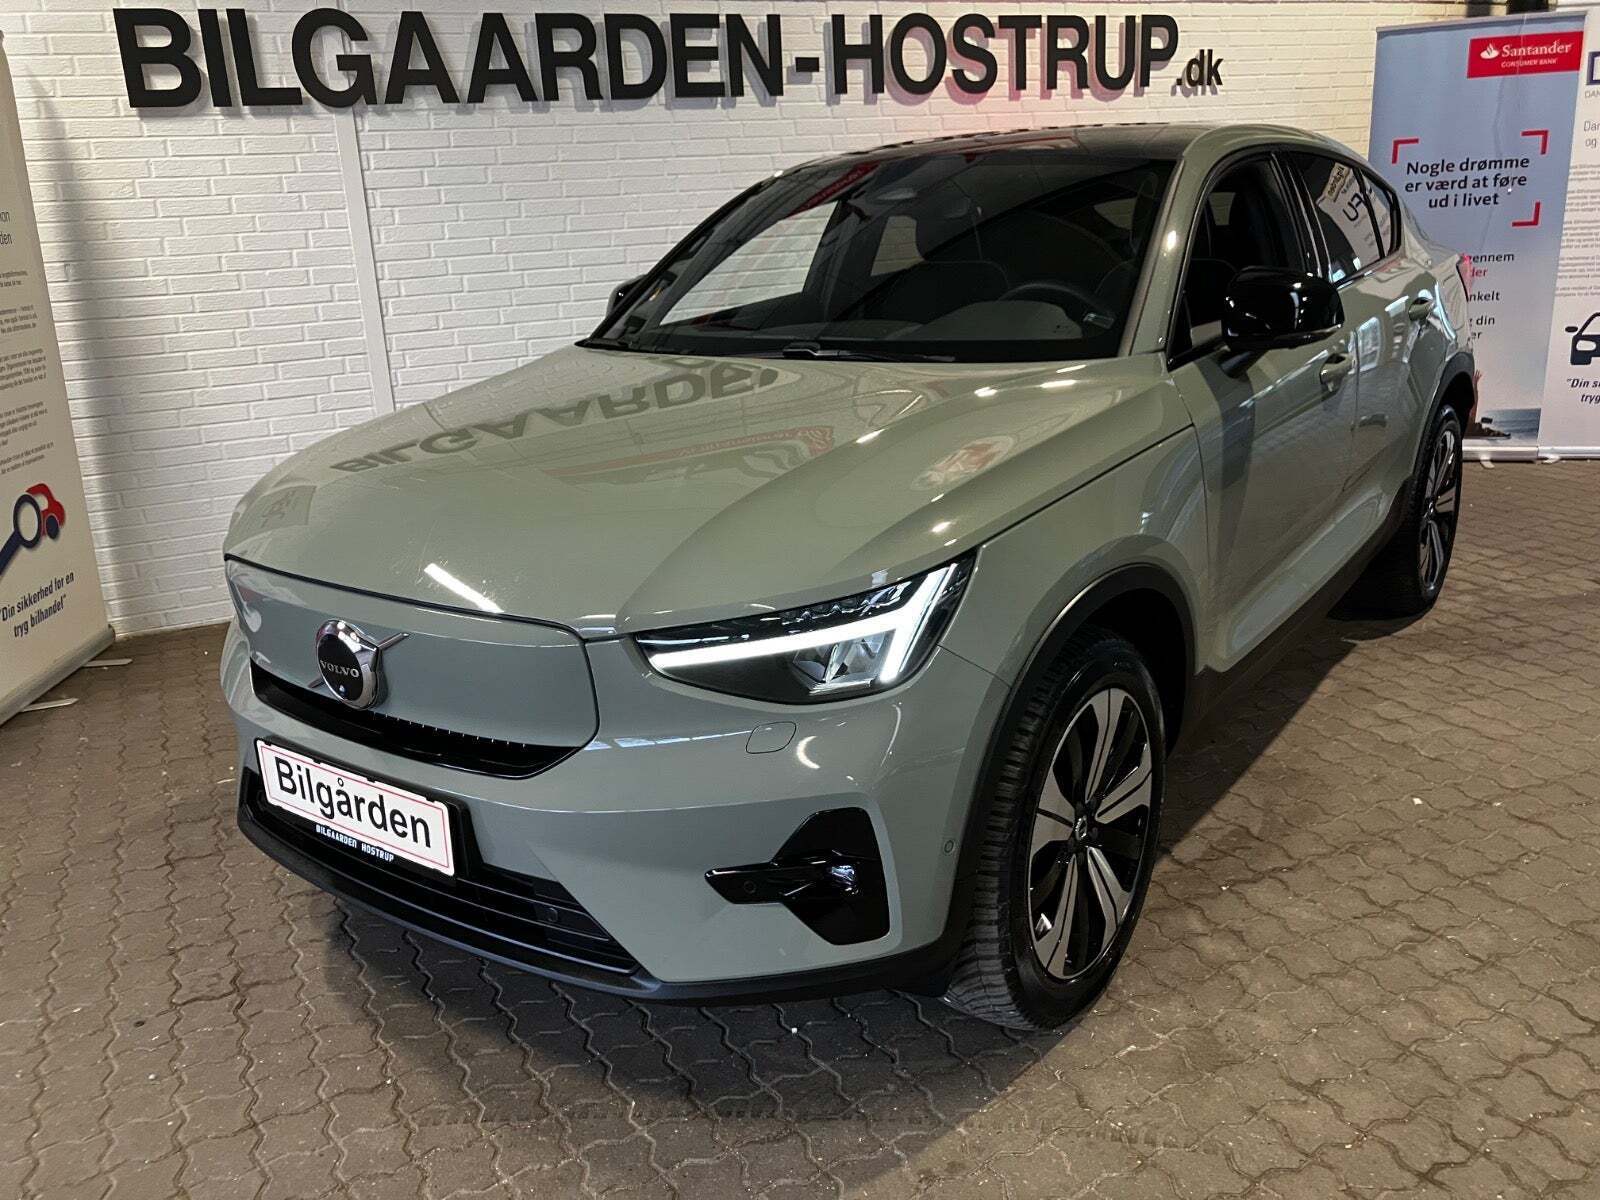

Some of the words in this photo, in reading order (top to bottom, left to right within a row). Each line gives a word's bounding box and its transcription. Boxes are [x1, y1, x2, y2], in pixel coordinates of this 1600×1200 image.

[1501, 39, 1572, 58] Santander
[1501, 59, 1537, 69] CONSUMER
[1539, 58, 1558, 66] BANK
[1406, 159, 1455, 177] Nogle
[1459, 157, 1530, 172] drømme
[1404, 181, 1421, 192] er
[1425, 175, 1468, 192] værd
[1471, 175, 1489, 189] at
[1492, 173, 1527, 188] føre
[1428, 194, 1449, 209] ud
[1453, 194, 1458, 207] i
[1462, 192, 1499, 207] livet
[1476, 315, 1496, 326] din
[16, 579, 54, 613] sikkerhed
[54, 577, 64, 591] for
[65, 572, 75, 585] en
[14, 620, 29, 638] tryg
[319, 659, 361, 678] VOLVO
[274, 756, 431, 849] Bilgården
[315, 824, 358, 849] BILGAARDEN
[361, 843, 395, 862] HOSTRUP
